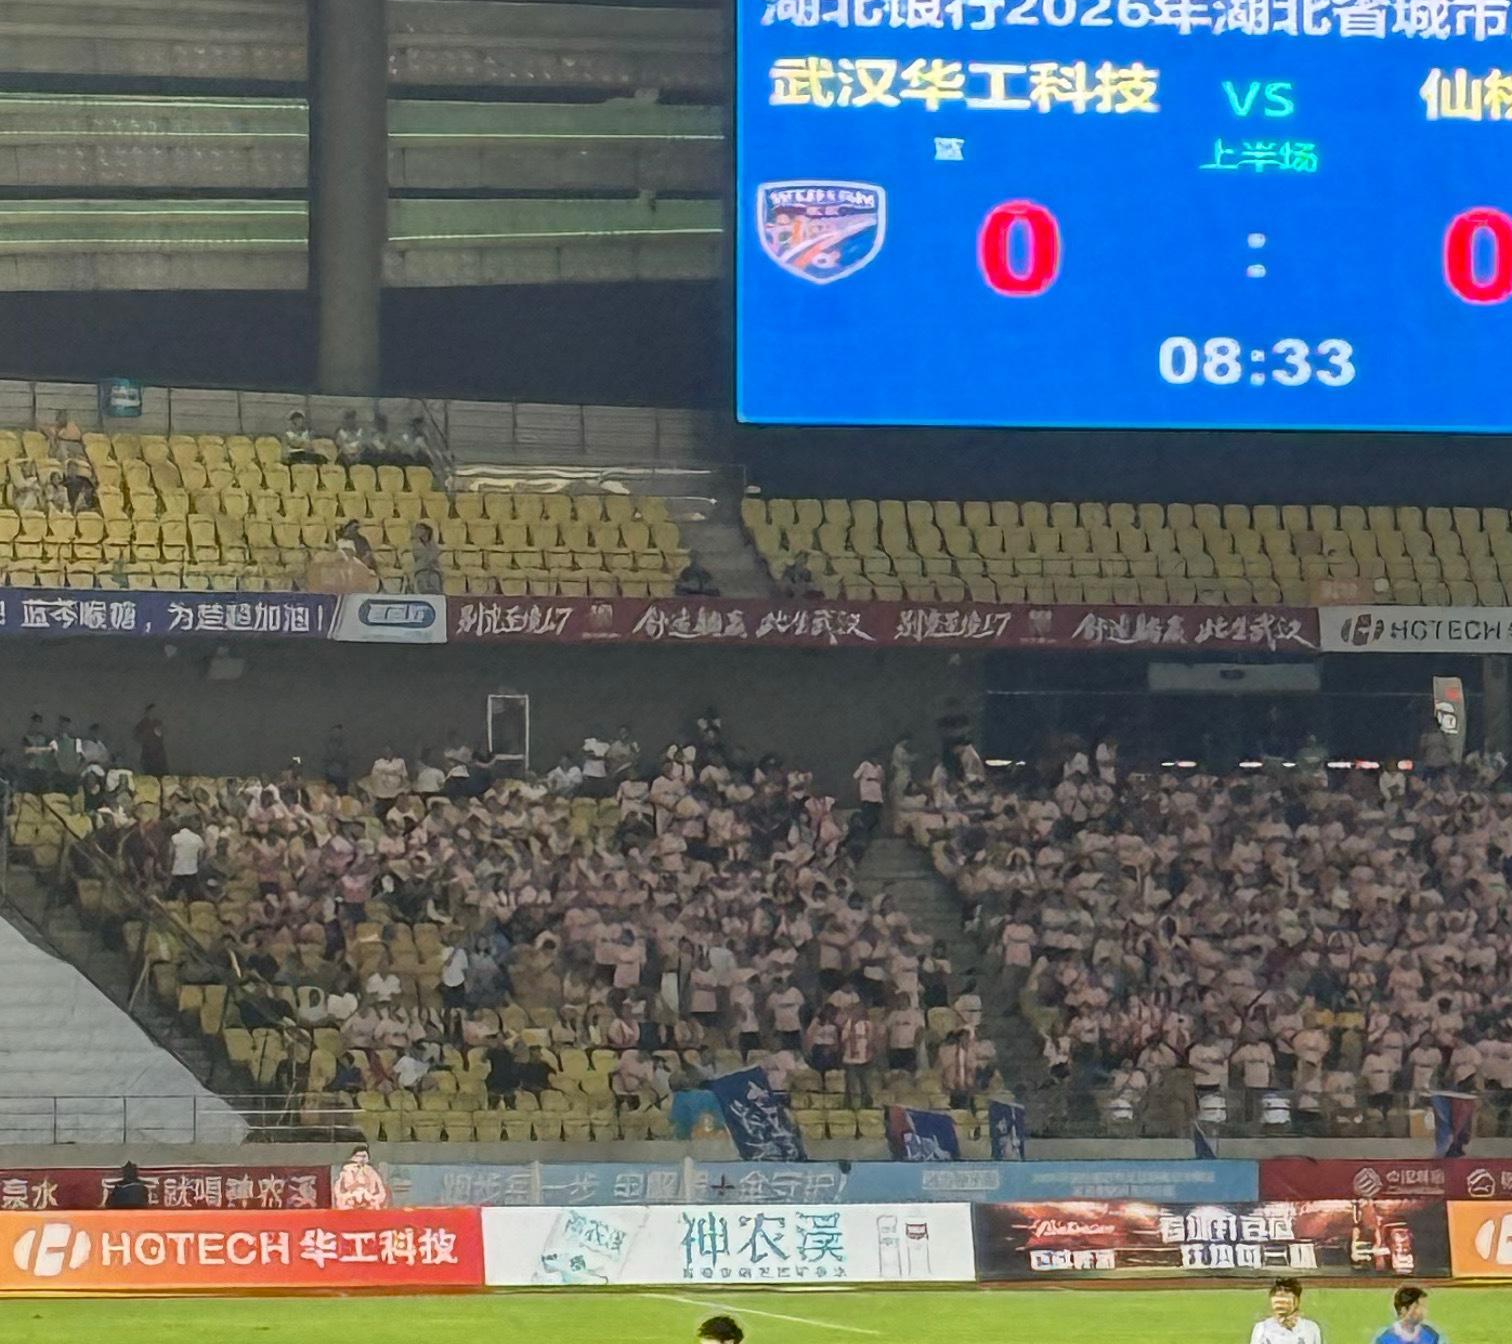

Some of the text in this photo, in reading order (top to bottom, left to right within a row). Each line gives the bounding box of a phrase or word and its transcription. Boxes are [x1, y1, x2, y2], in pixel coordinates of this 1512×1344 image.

[768, 59, 1162, 114] 武汉华工科技
[1222, 82, 1295, 119] VS
[1199, 141, 1319, 175] 上半场
[977, 199, 1062, 299] 0
[1158, 336, 1358, 389] 08:33
[300, 1228, 459, 1269] 华工科技
